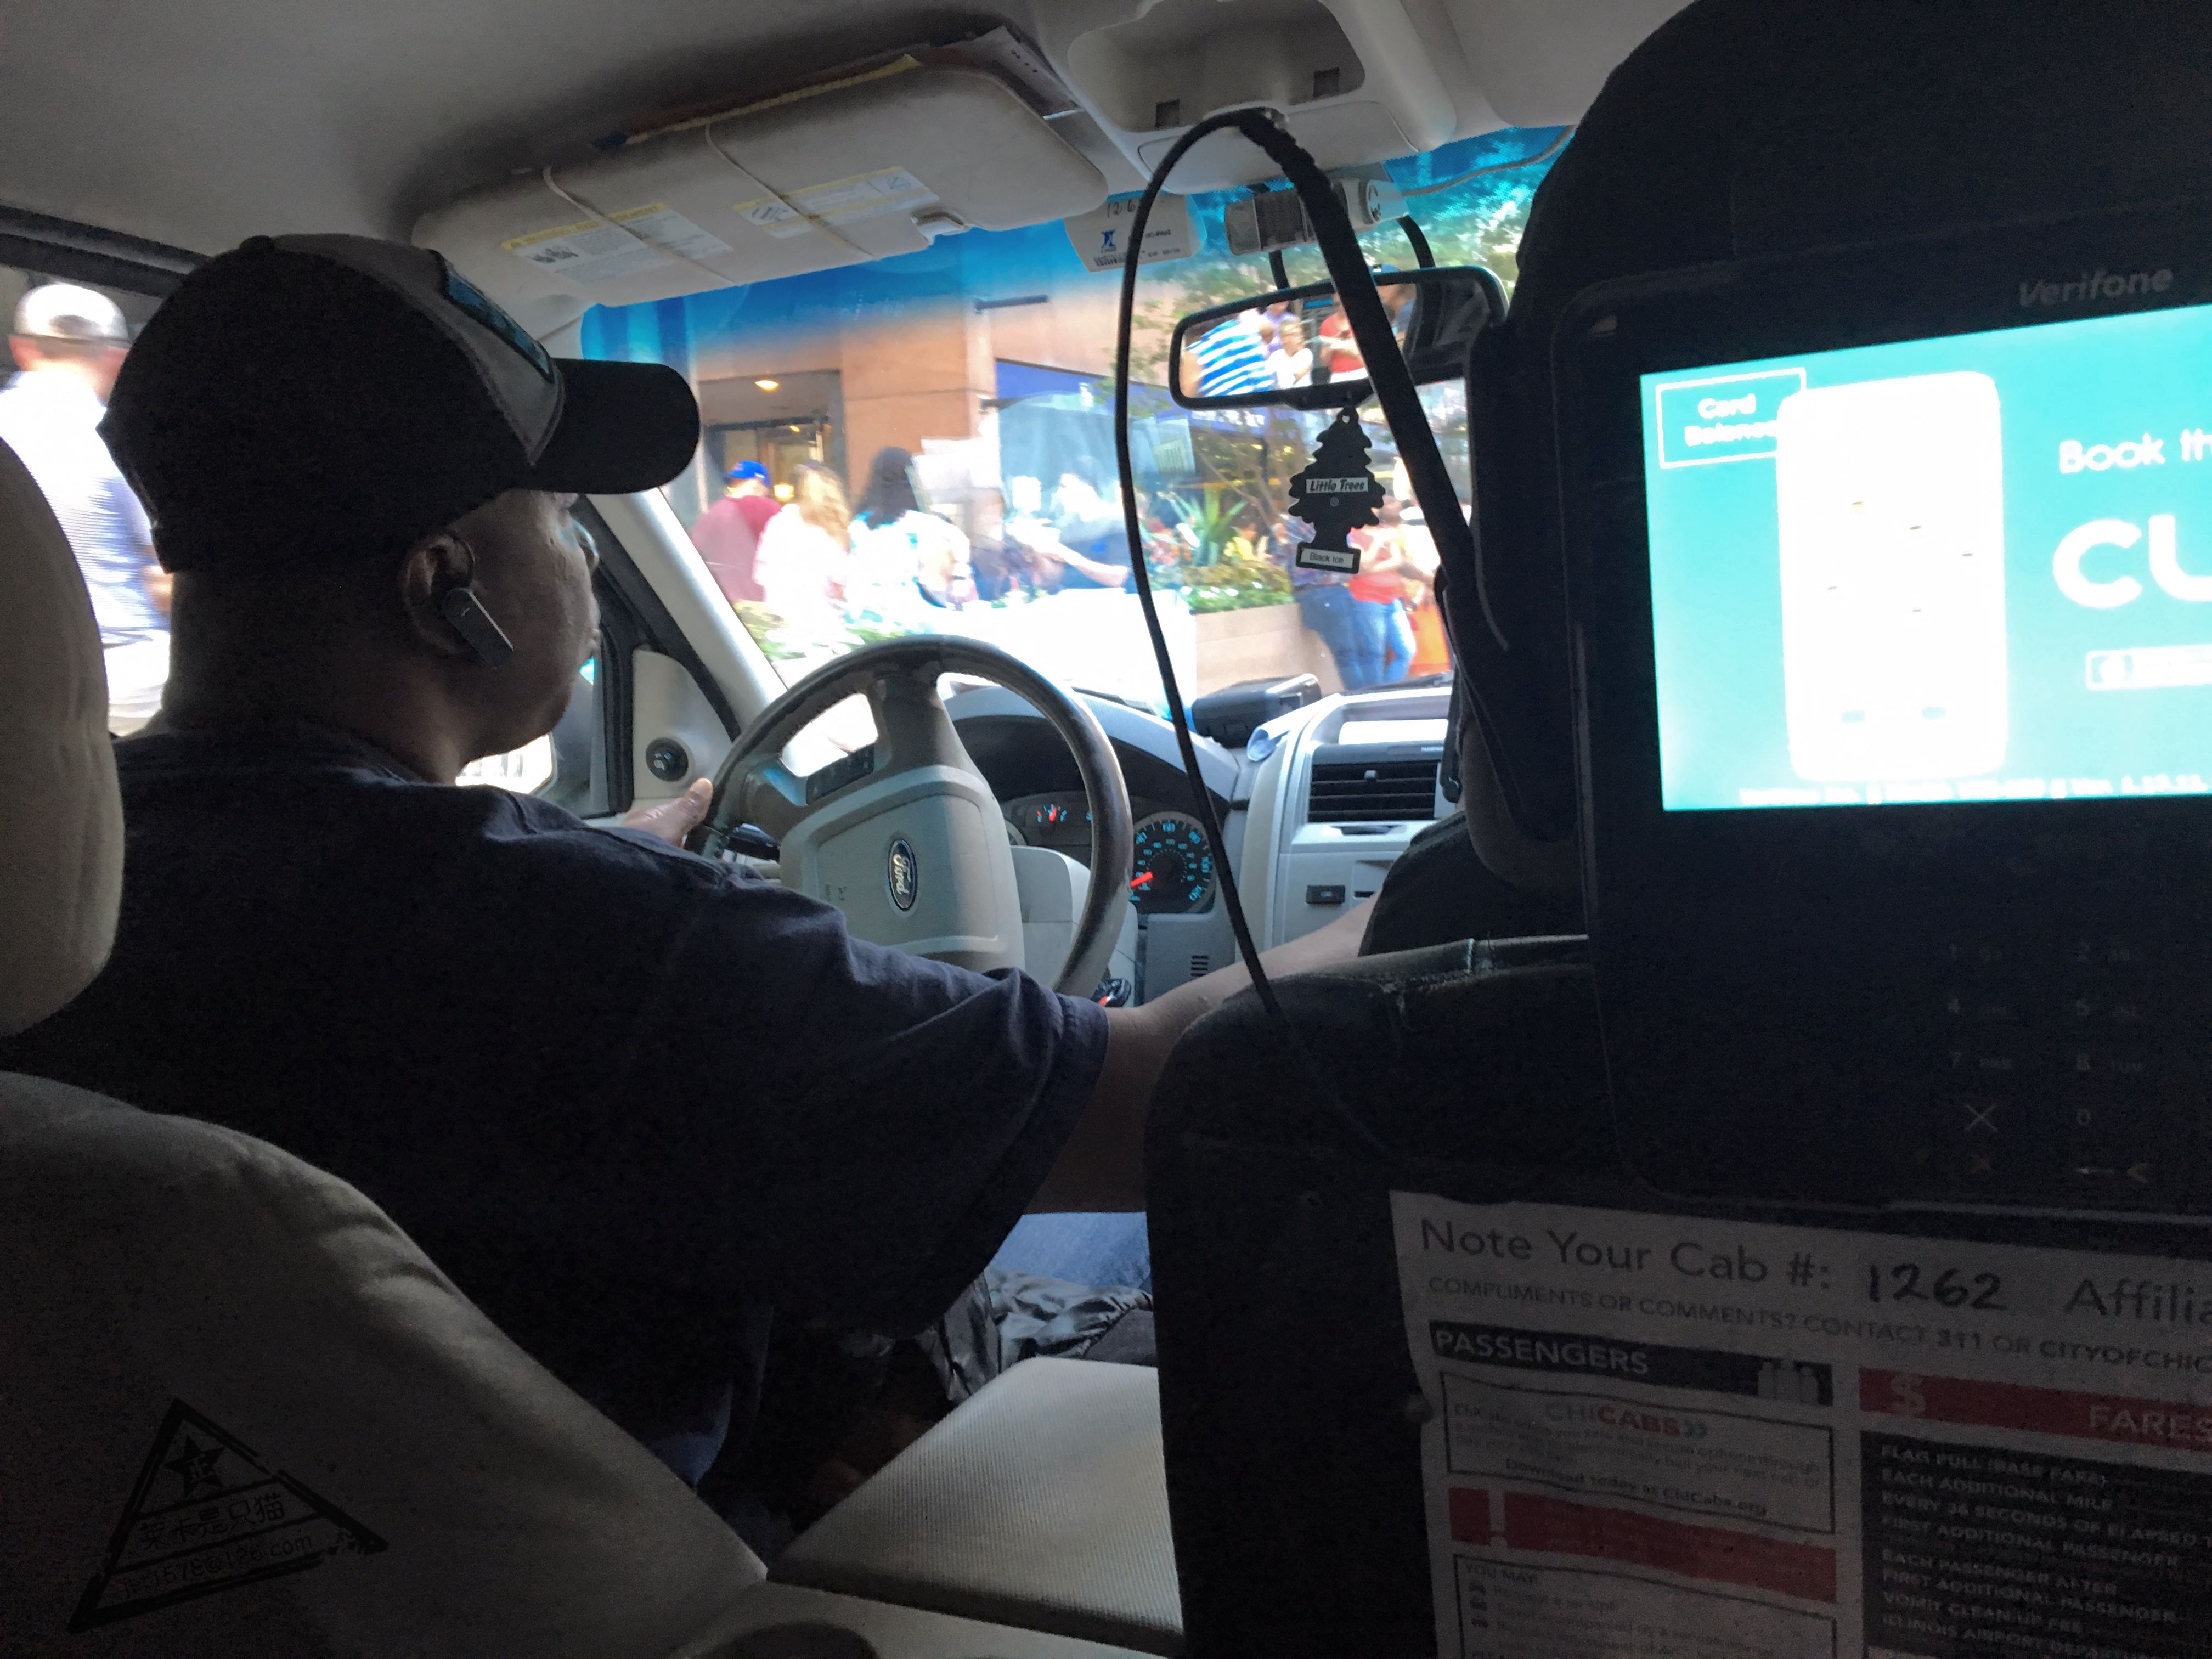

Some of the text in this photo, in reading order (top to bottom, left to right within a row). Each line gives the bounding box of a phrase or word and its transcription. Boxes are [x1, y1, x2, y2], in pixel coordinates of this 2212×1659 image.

[2019, 268, 2174, 307] Verifone
[2059, 432, 2165, 474] Book
[1310, 478, 1365, 492] Little Trees
[1310, 552, 1344, 564] Black Ice
[893, 854, 911, 895] Ford
[1420, 1217, 1829, 1289] Note Your Cab #:
[1869, 1263, 2007, 1311] 1262
[1429, 1277, 1592, 1308] COMPLIMENTS
[1599, 1291, 1630, 1311] OR
[1639, 1297, 1795, 1329] COMMENTS?
[1803, 1314, 1927, 1342] CONTACT
[1938, 1329, 1982, 1350] 311
[1992, 1335, 2031, 1354] OR
[1434, 1329, 1647, 1374] PASSENGERS
[2089, 1404, 2212, 1443] FARES
[1505, 1458, 1584, 1484] Download
[1882, 1468, 2113, 1511] EACH ADDITIONAL MILE
[1937, 1524, 2055, 1551] ADDITIONAL
